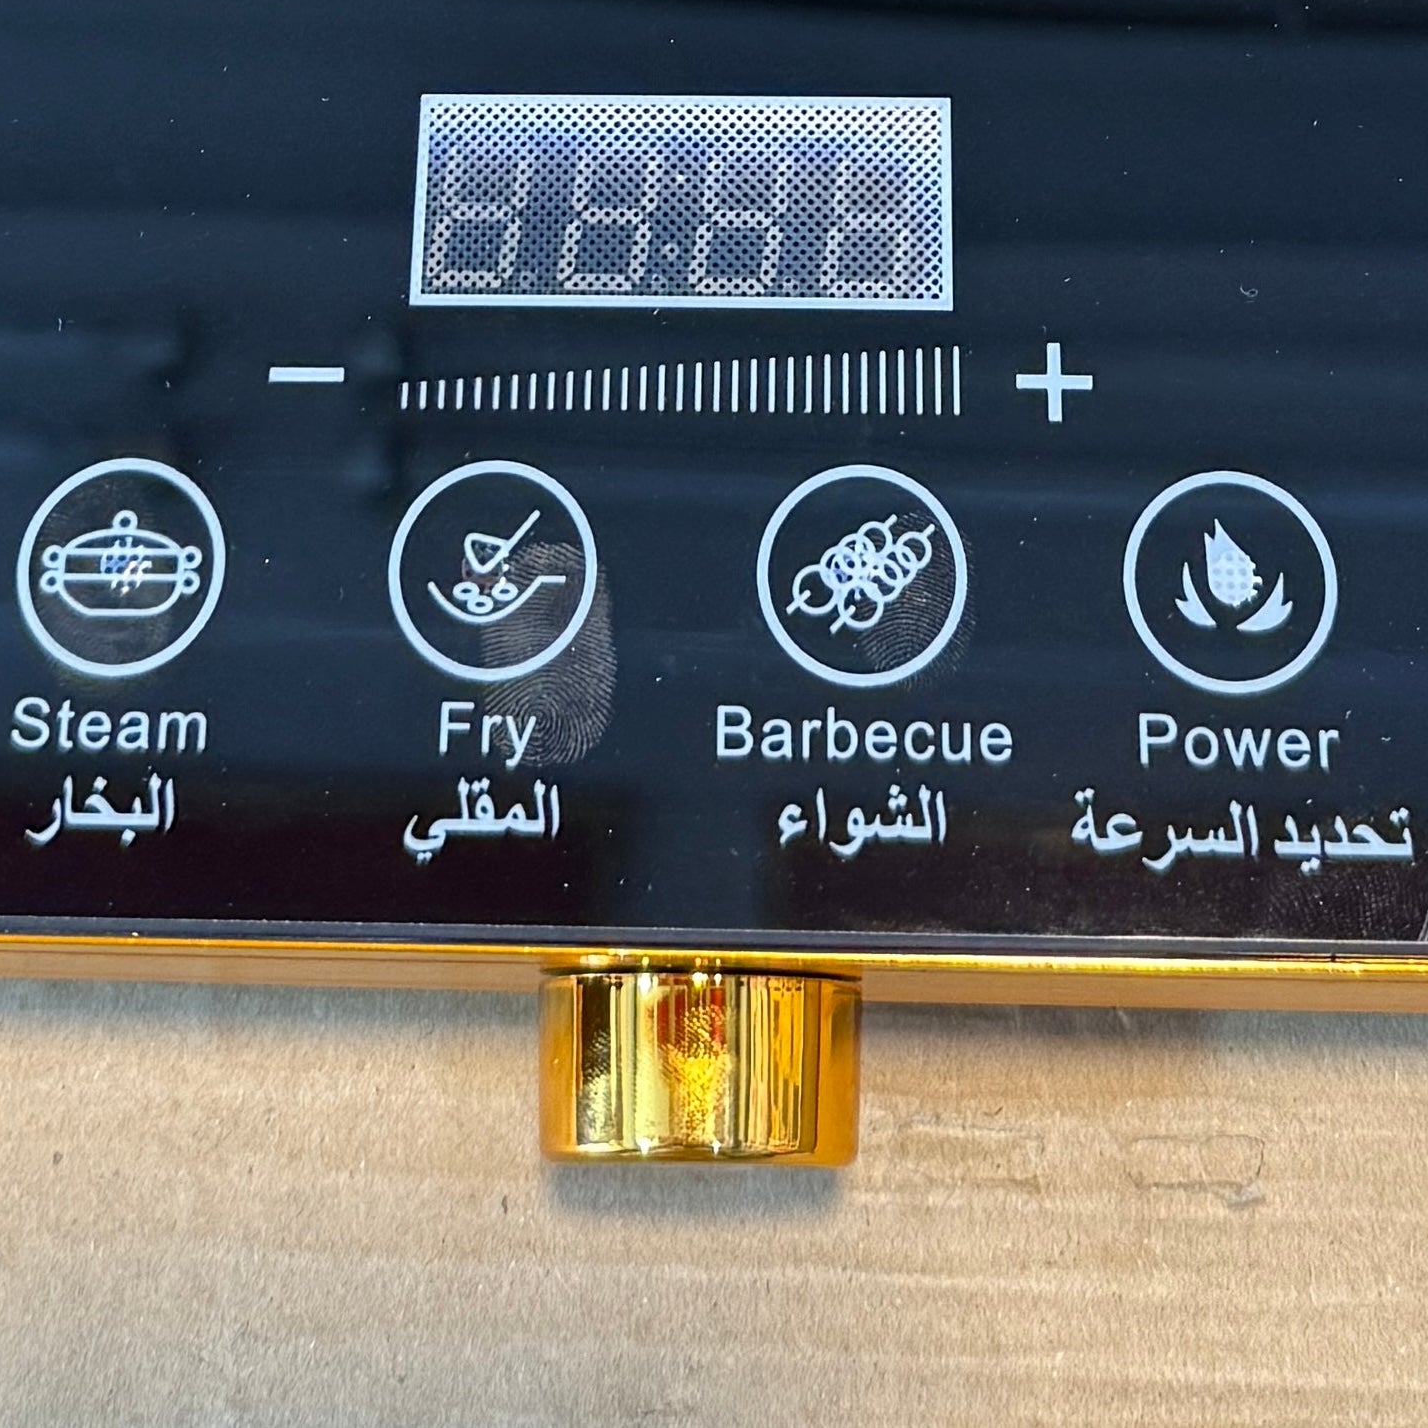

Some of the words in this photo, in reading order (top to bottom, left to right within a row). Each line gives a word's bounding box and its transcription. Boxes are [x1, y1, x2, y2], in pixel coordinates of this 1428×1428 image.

[9, 695, 208, 752] Steam
[438, 701, 538, 768] Fry
[715, 704, 1014, 762] Barbecue
[1137, 712, 1340, 771] Power
[25, 772, 176, 847] البخار
[403, 775, 561, 864] المقلي
[777, 783, 948, 856] الشواء
[1070, 786, 1260, 871] السرعة
[1273, 806, 1414, 872] تحديد
